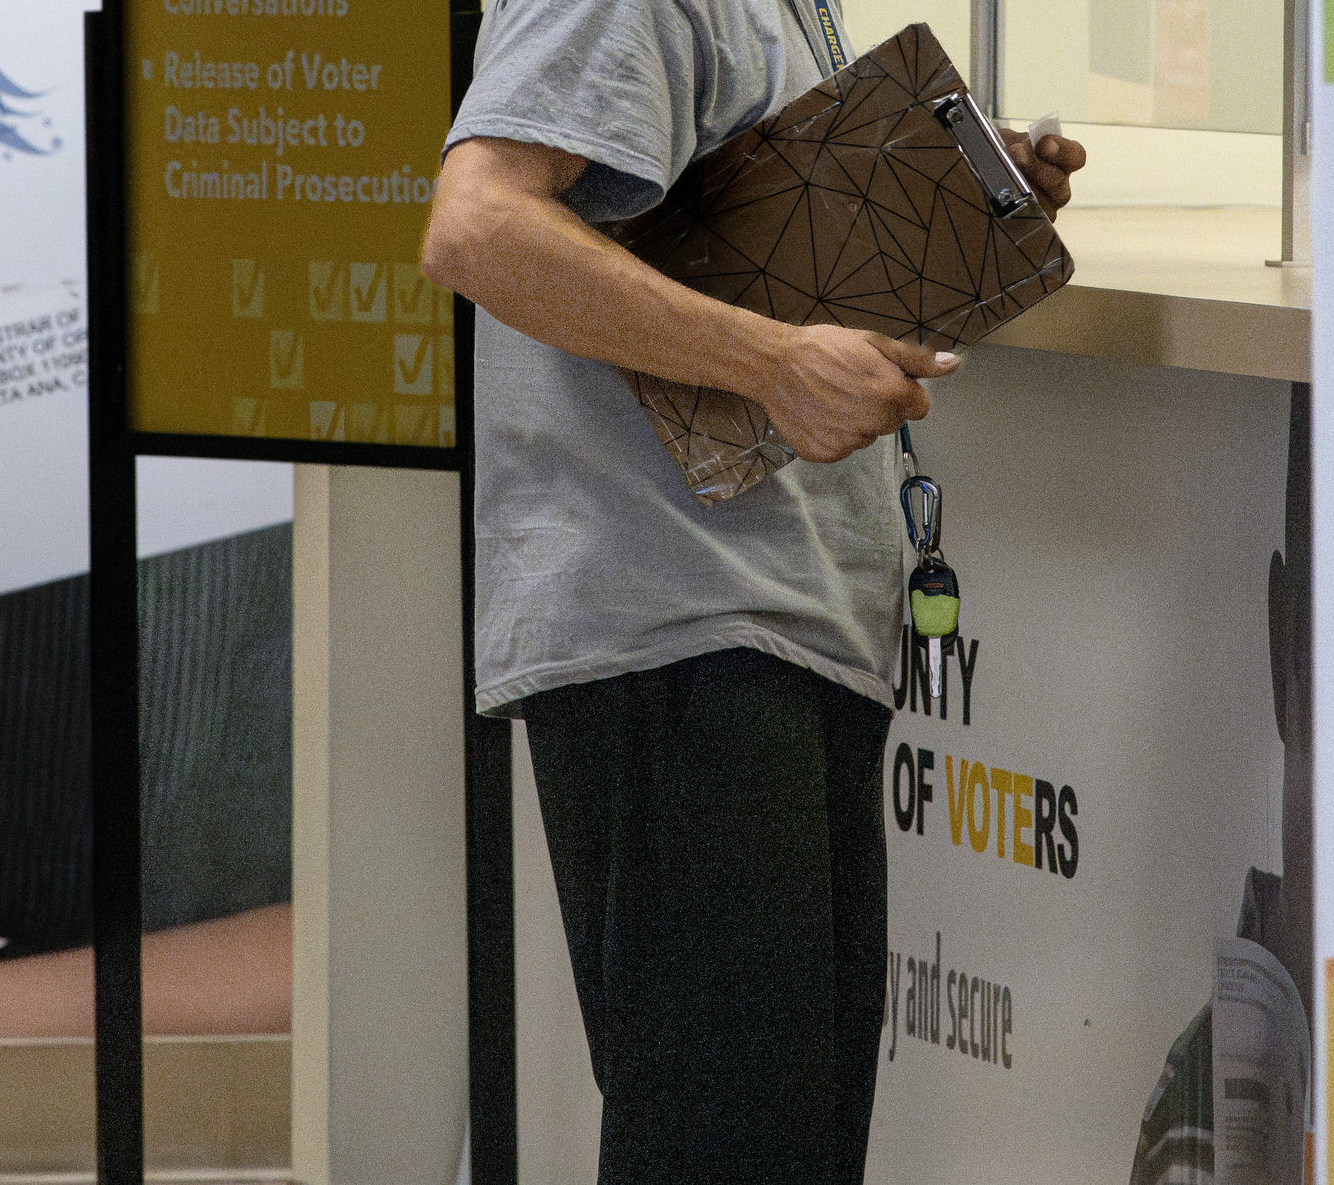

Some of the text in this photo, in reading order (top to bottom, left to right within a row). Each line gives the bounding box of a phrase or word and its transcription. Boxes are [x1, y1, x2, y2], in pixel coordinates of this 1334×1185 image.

[164, 50, 382, 92] Release of Voter
[165, 106, 365, 156] Data Subject to
[164, 160, 267, 200] Criminal
[893, 743, 1079, 879] OF VOTERS
[906, 931, 940, 1045] and
[946, 969, 1013, 1069] secure
